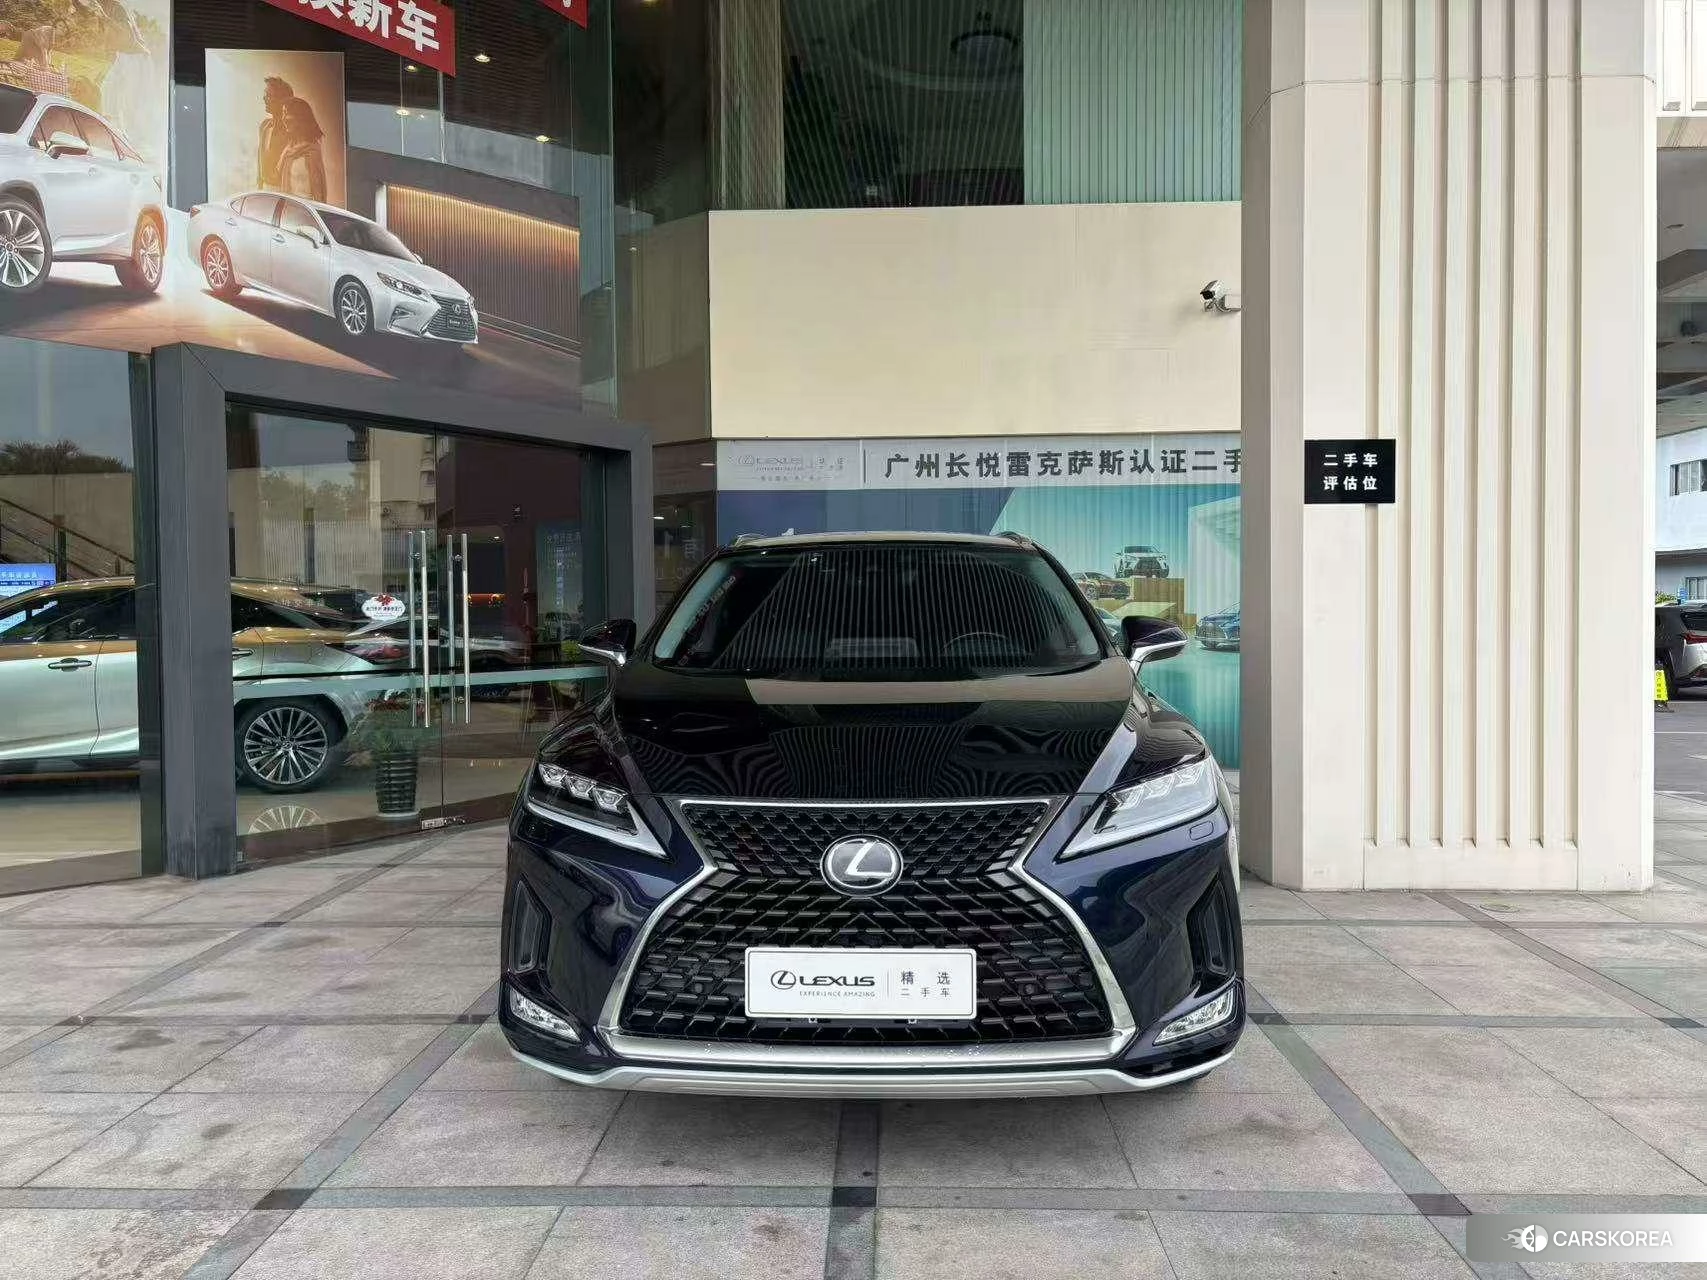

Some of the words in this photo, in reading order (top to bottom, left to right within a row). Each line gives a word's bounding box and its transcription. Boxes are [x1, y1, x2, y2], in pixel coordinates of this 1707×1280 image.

[885, 448, 1241, 478] 广州长悦雷克萨斯认证二手
[1323, 452, 1378, 467] 二手车
[1323, 475, 1378, 491] 评估位
[799, 975, 875, 987] LEXUS
[900, 970, 951, 985] 精选
[799, 990, 841, 998] EXPERIENCE
[844, 990, 875, 998] AMAZING
[900, 987, 950, 998] 二手车
